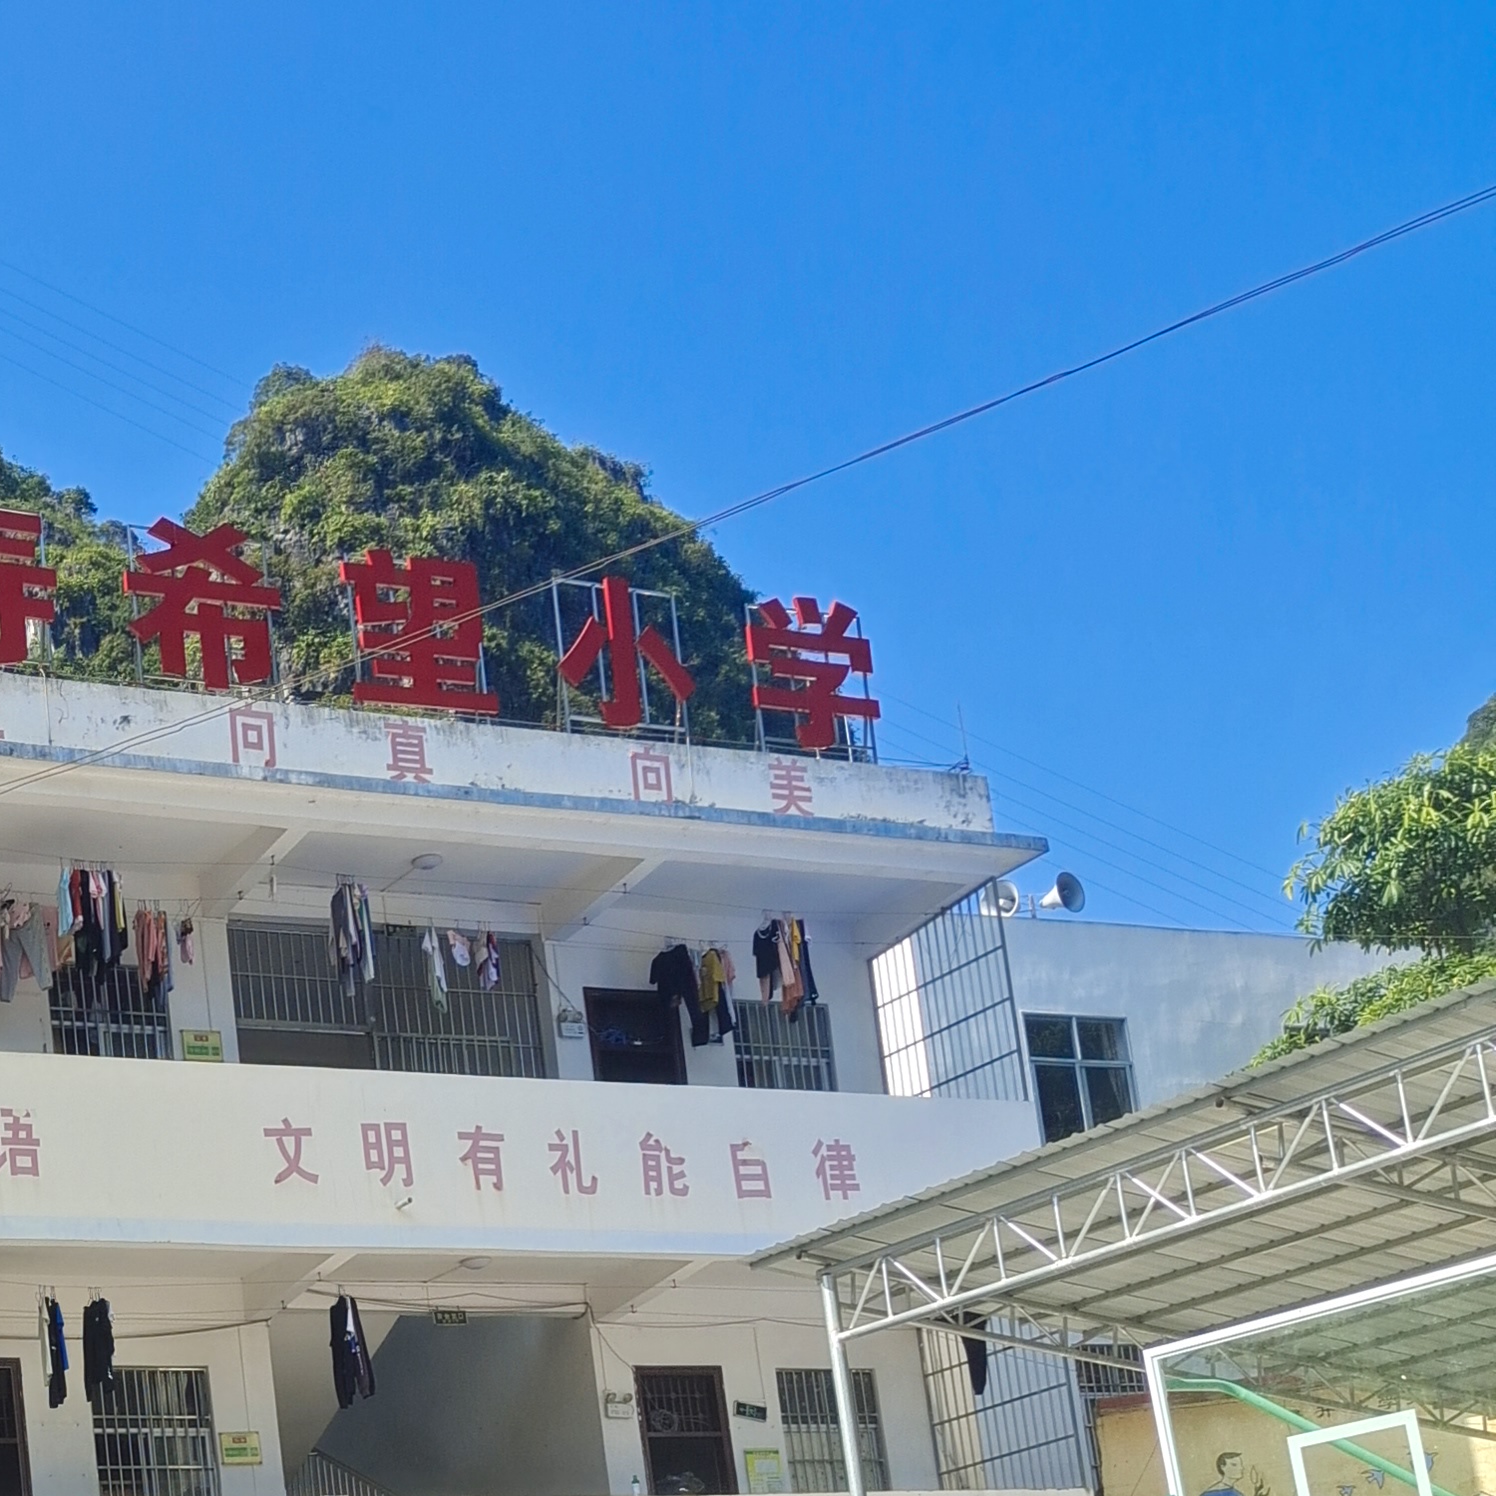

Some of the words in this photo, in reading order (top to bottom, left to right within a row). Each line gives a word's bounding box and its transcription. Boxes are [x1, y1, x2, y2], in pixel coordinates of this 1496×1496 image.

[263, 1118, 860, 1200] 文明有礼能自律
